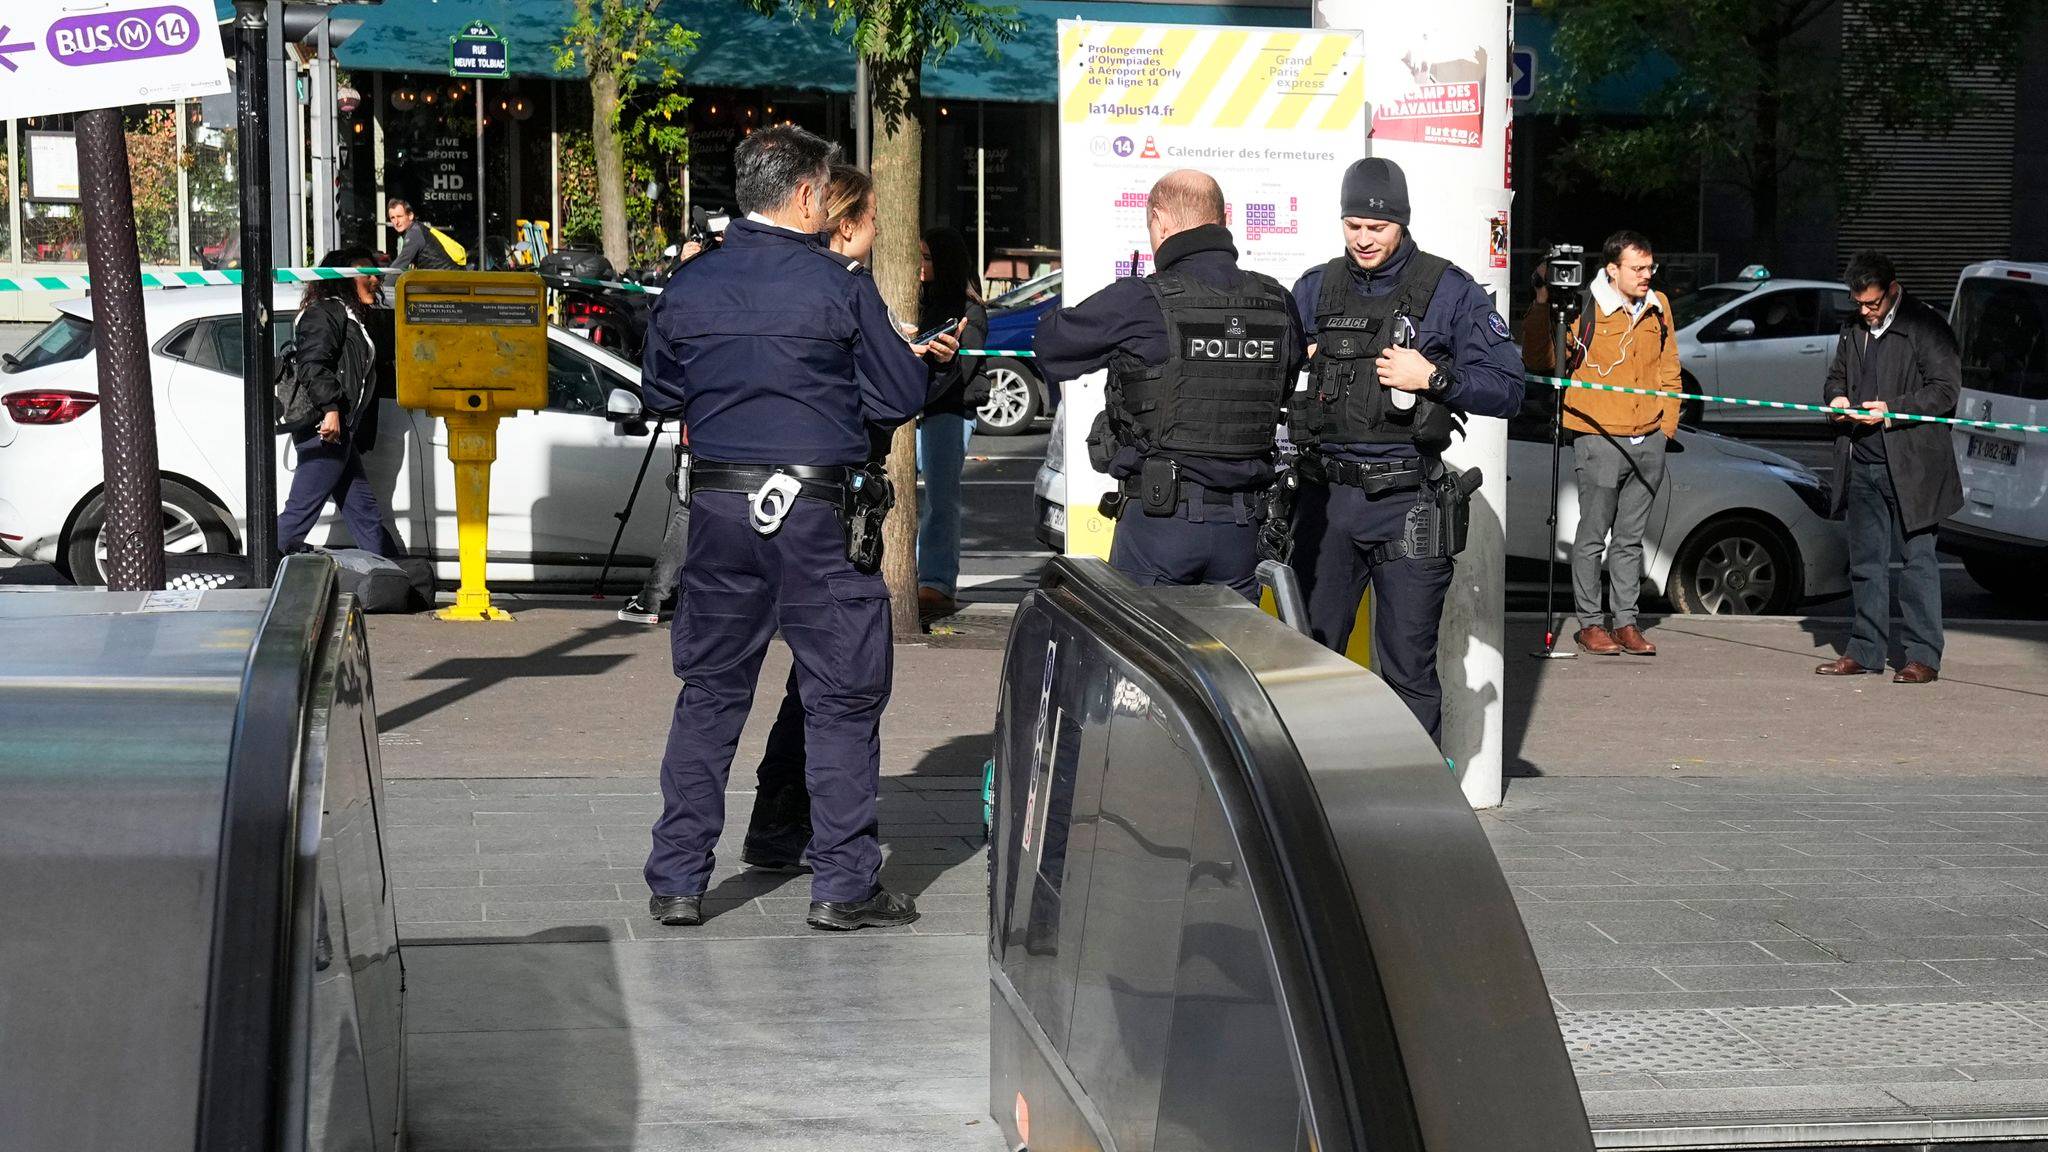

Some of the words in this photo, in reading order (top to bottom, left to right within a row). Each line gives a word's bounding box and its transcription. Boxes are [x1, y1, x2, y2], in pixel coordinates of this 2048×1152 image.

[157, 19, 186, 41] 14
[472, 45, 487, 55] RUE
[1088, 44, 1164, 56] Prolongement
[454, 57, 477, 67] NEUVE
[478, 58, 505, 69] TOLBIAC
[1088, 55, 1161, 67] d'Olympiades
[1275, 54, 1312, 66] Grand
[1088, 65, 1094, 74] à
[1098, 66, 1146, 77] Aéroport
[1149, 68, 1181, 79] d'Orly
[1269, 66, 1300, 77] Paris
[1088, 76, 1101, 85] de
[1104, 77, 1114, 86] la
[1117, 77, 1144, 88] ligne
[1147, 78, 1159, 87] 14
[1277, 79, 1325, 90] express
[1447, 85, 1471, 98] DES
[1088, 102, 1175, 117] la14plus14.fr
[1384, 100, 1476, 117] TRAVAILLEURS
[435, 137, 460, 147] LIVE
[427, 150, 469, 159] SPORTS
[1114, 140, 1132, 154] 14
[1167, 146, 1235, 158] Calendrier
[1238, 148, 1261, 159] des
[1264, 148, 1335, 160] fermetures
[440, 163, 456, 171] ON
[433, 174, 464, 190] HD
[424, 192, 473, 201] SCREENS
[1328, 317, 1367, 328] POLICE
[1191, 339, 1275, 359] POLICE
